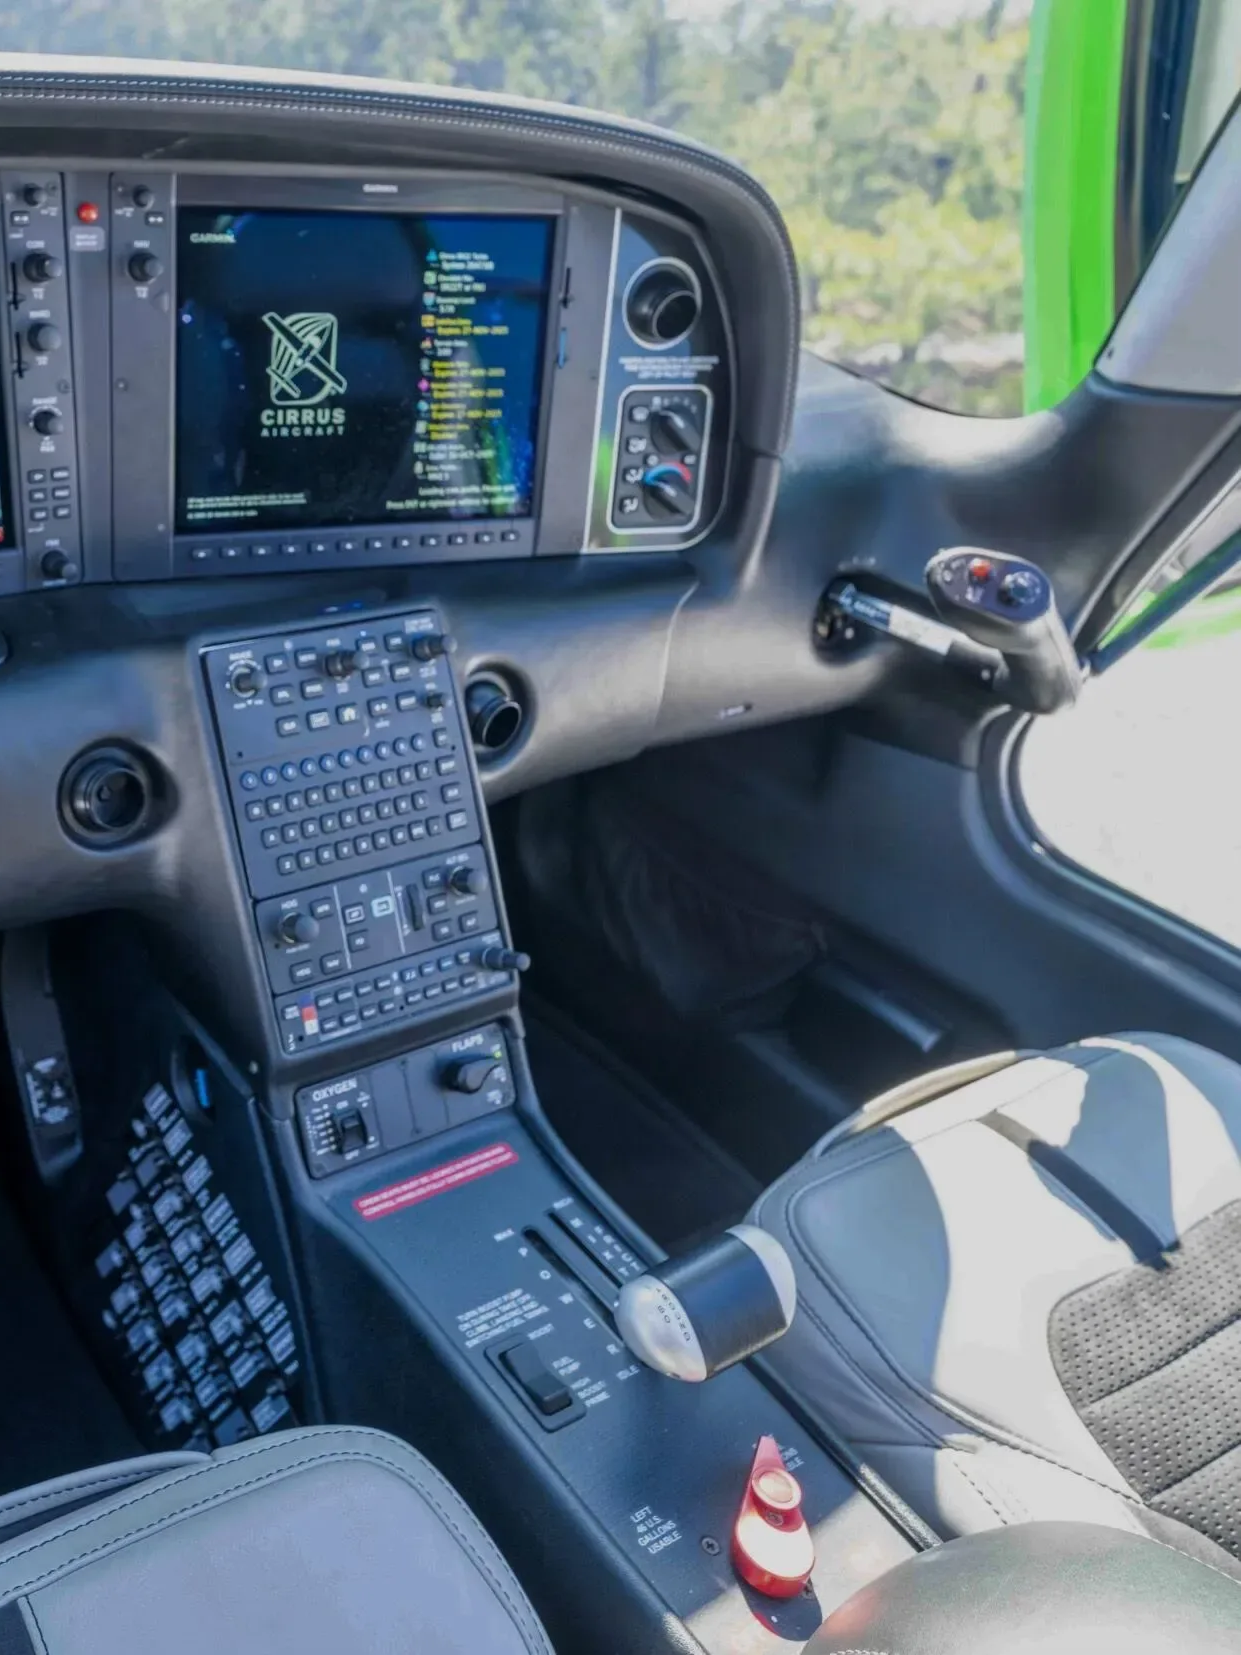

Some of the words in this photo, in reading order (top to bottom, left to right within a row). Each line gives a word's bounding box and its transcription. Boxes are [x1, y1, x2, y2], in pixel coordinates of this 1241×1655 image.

[260, 408, 346, 426] CIRRUS
[260, 426, 344, 438] AIRCRAFT
[452, 1033, 484, 1053] FLAPS
[312, 1078, 358, 1102] OXYGEN
[630, 1506, 652, 1524] LEFT
[638, 1520, 677, 1547] GALLONS
[648, 1532, 682, 1555] USABLE
